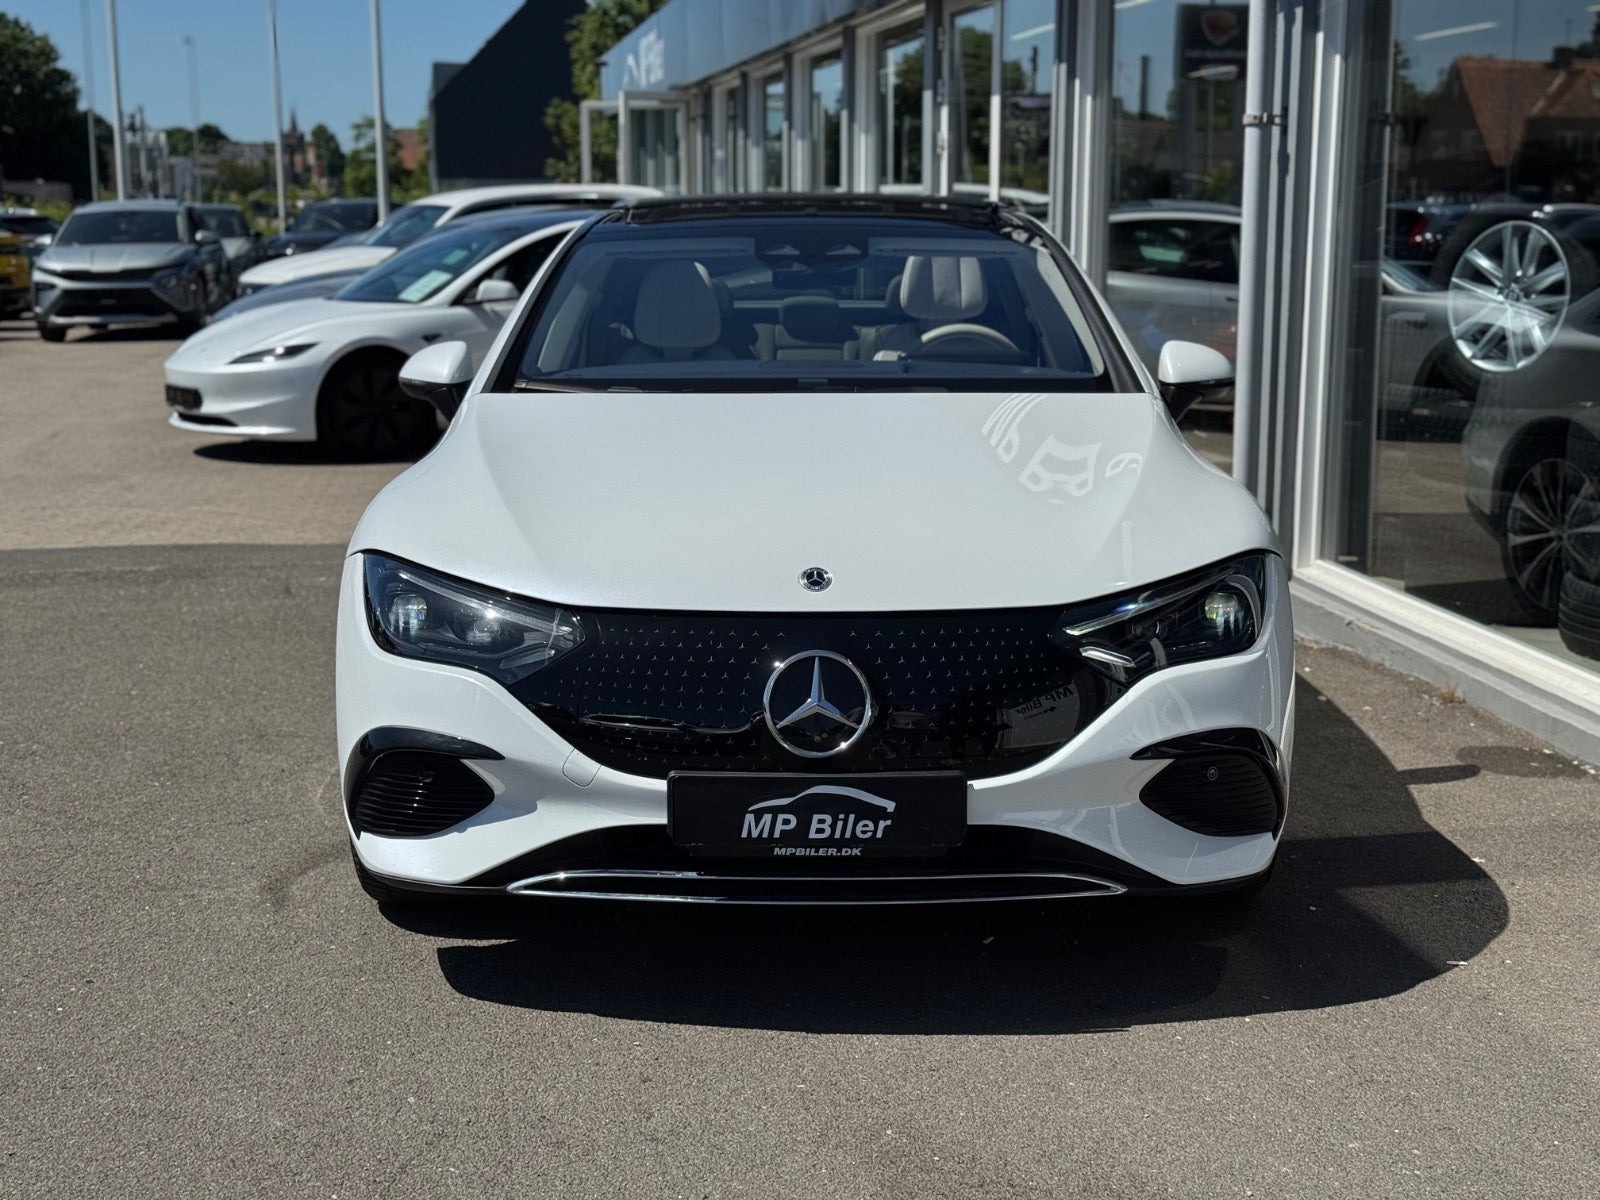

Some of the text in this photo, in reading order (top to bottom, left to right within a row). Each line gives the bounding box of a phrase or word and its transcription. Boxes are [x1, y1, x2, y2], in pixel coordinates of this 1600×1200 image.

[741, 813, 892, 839] MP Biler
[773, 847, 862, 856] MPBILER.DK
